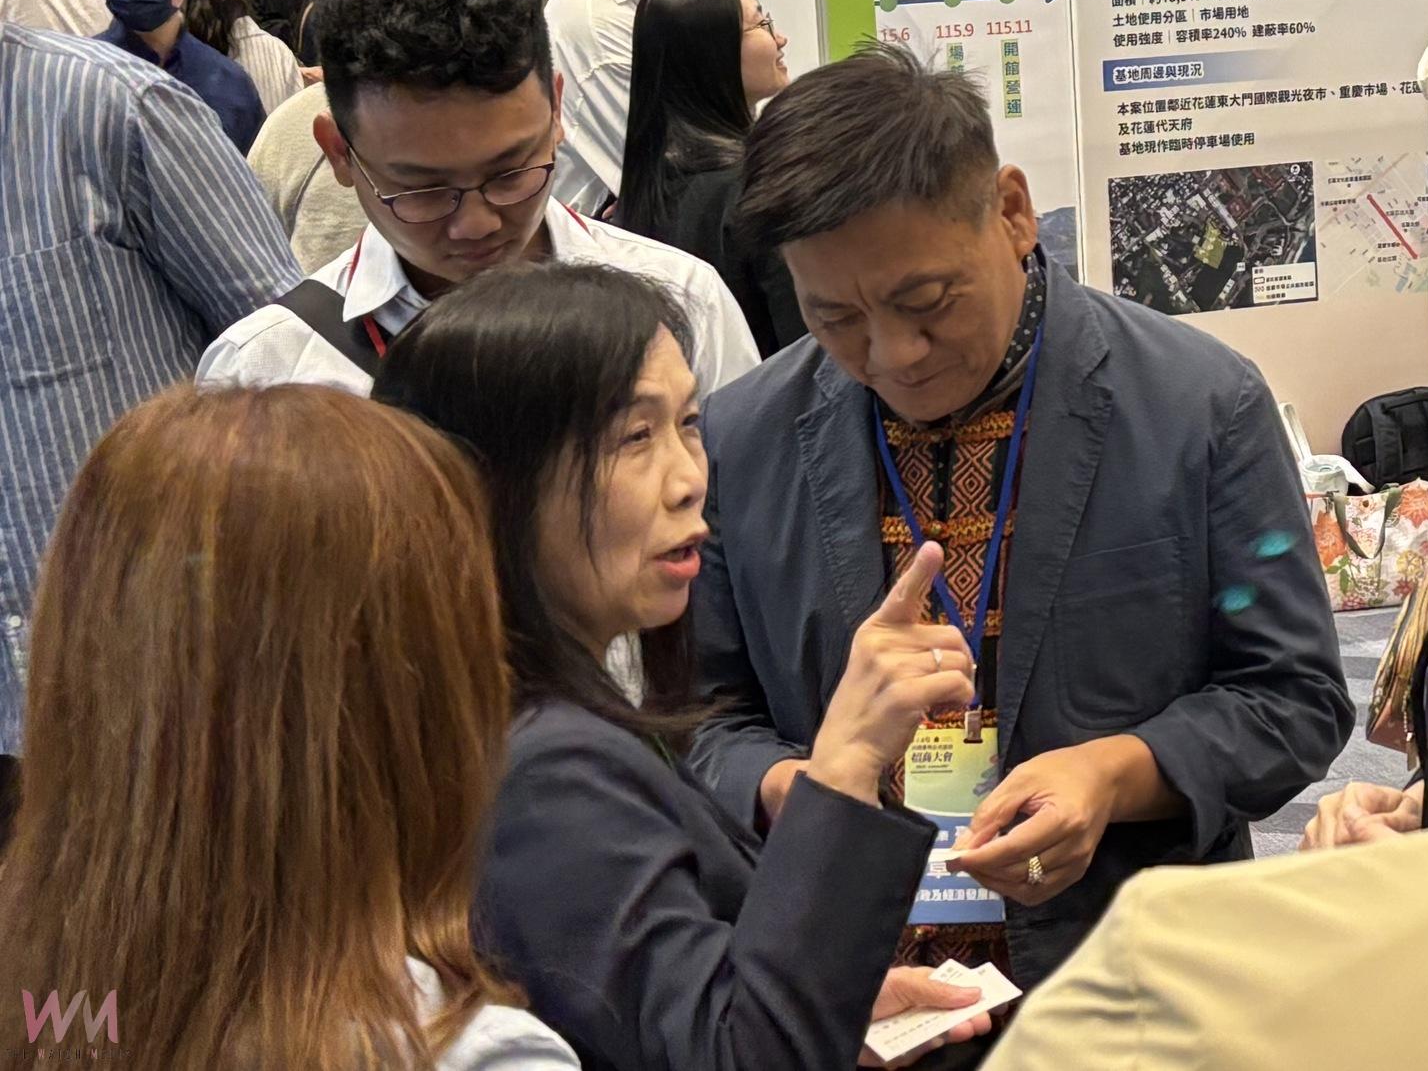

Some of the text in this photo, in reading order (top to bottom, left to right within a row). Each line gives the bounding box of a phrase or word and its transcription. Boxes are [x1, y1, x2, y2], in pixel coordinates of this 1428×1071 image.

[1112, 6, 1249, 27] 土地使用分區 市場用地
[880, 20, 1033, 42] 15.6 115.9 115.11
[1113, 22, 1315, 47] 使用強度 容積率240% 建蔽率60%
[1115, 63, 1203, 82] 基地周邊與現況
[1118, 117, 1192, 135] 及花蓮代天府
[1119, 133, 1255, 156] 基地現作臨時停車場使用
